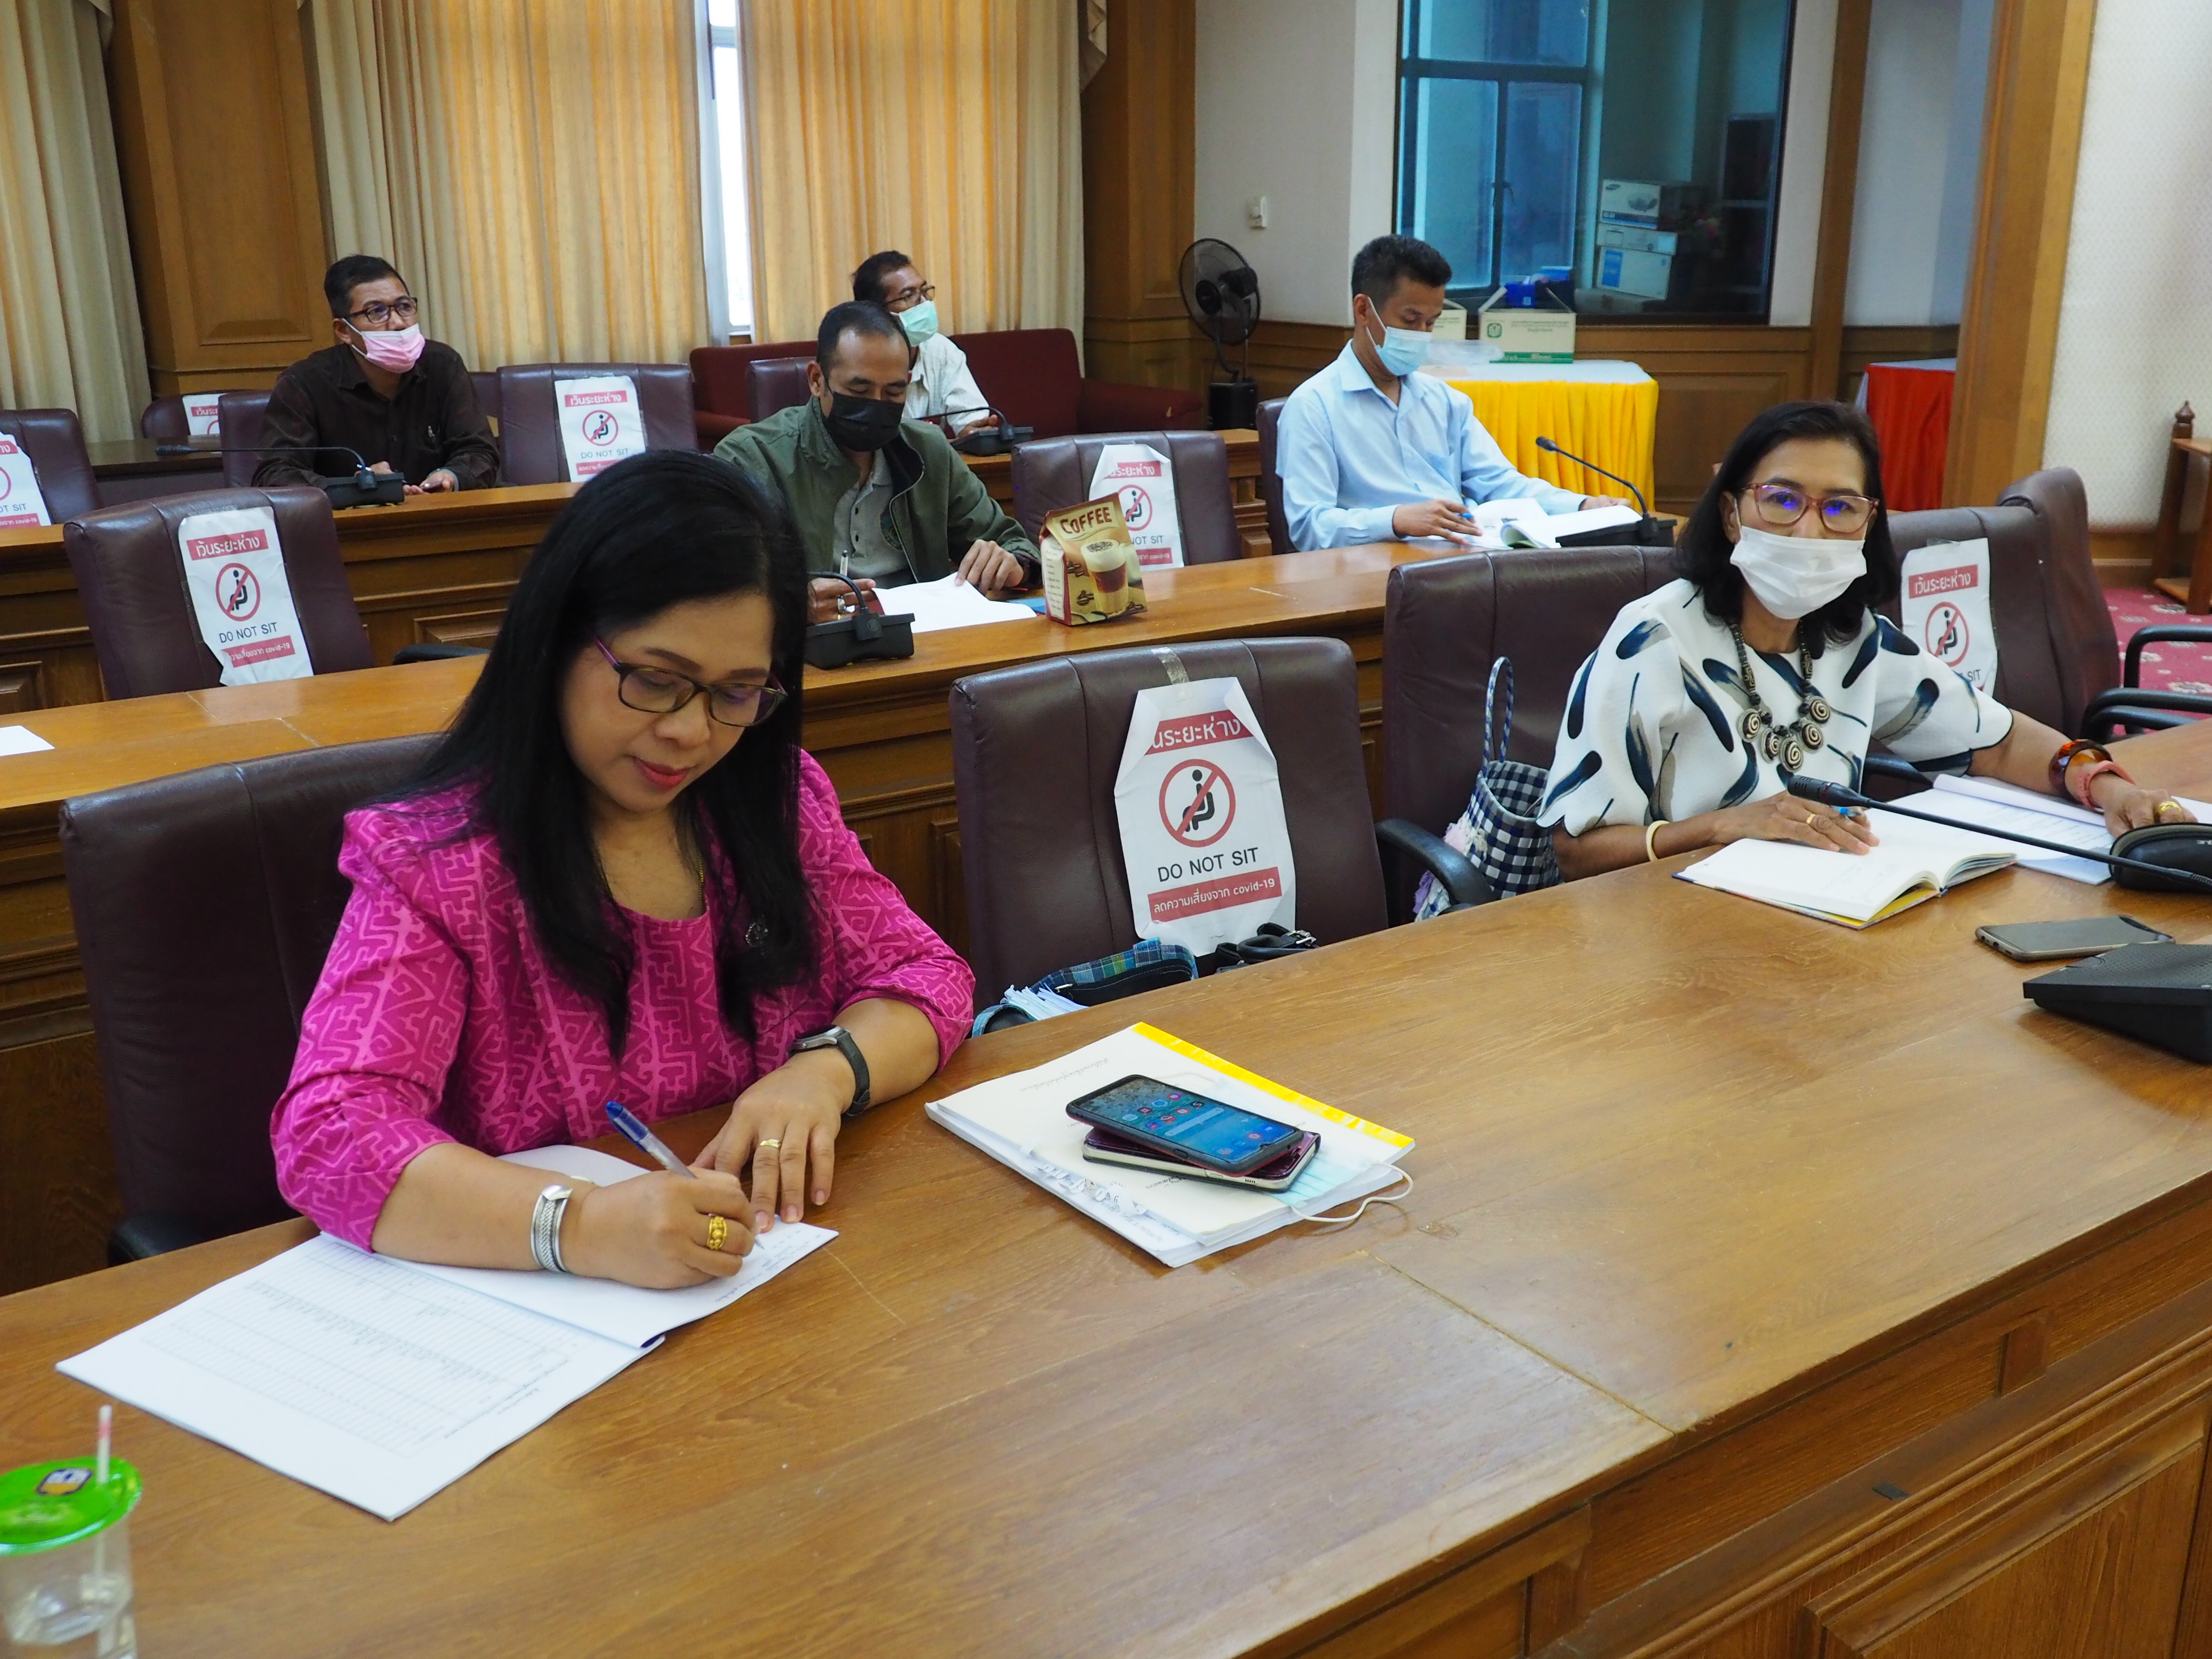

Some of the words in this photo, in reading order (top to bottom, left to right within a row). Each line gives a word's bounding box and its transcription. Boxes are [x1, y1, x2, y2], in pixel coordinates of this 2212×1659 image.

[570, 393, 622, 406] เว้นระยะห่าง
[1060, 506, 1112, 534] COFFEE
[196, 534, 260, 557] เว้นระยะห่าง
[1151, 535, 1164, 543] SIT
[1915, 569, 1971, 594] เว้นระยะห่าง
[219, 631, 234, 643] DO
[236, 626, 257, 640] NOT
[261, 622, 277, 634] SIT
[230, 648, 264, 661] วามเสี่ยงจาก
[265, 642, 290, 654] covid-19
[1968, 669, 1981, 682] SIT
[1152, 716, 1241, 748] นระยะห่าง
[1158, 864, 1182, 882] DO
[1189, 854, 1224, 875] NOT
[1232, 847, 1258, 866] SIT
[1154, 889, 1230, 913] ลดความเสี่ยงจาก
[1233, 878, 1275, 895] covid-19
